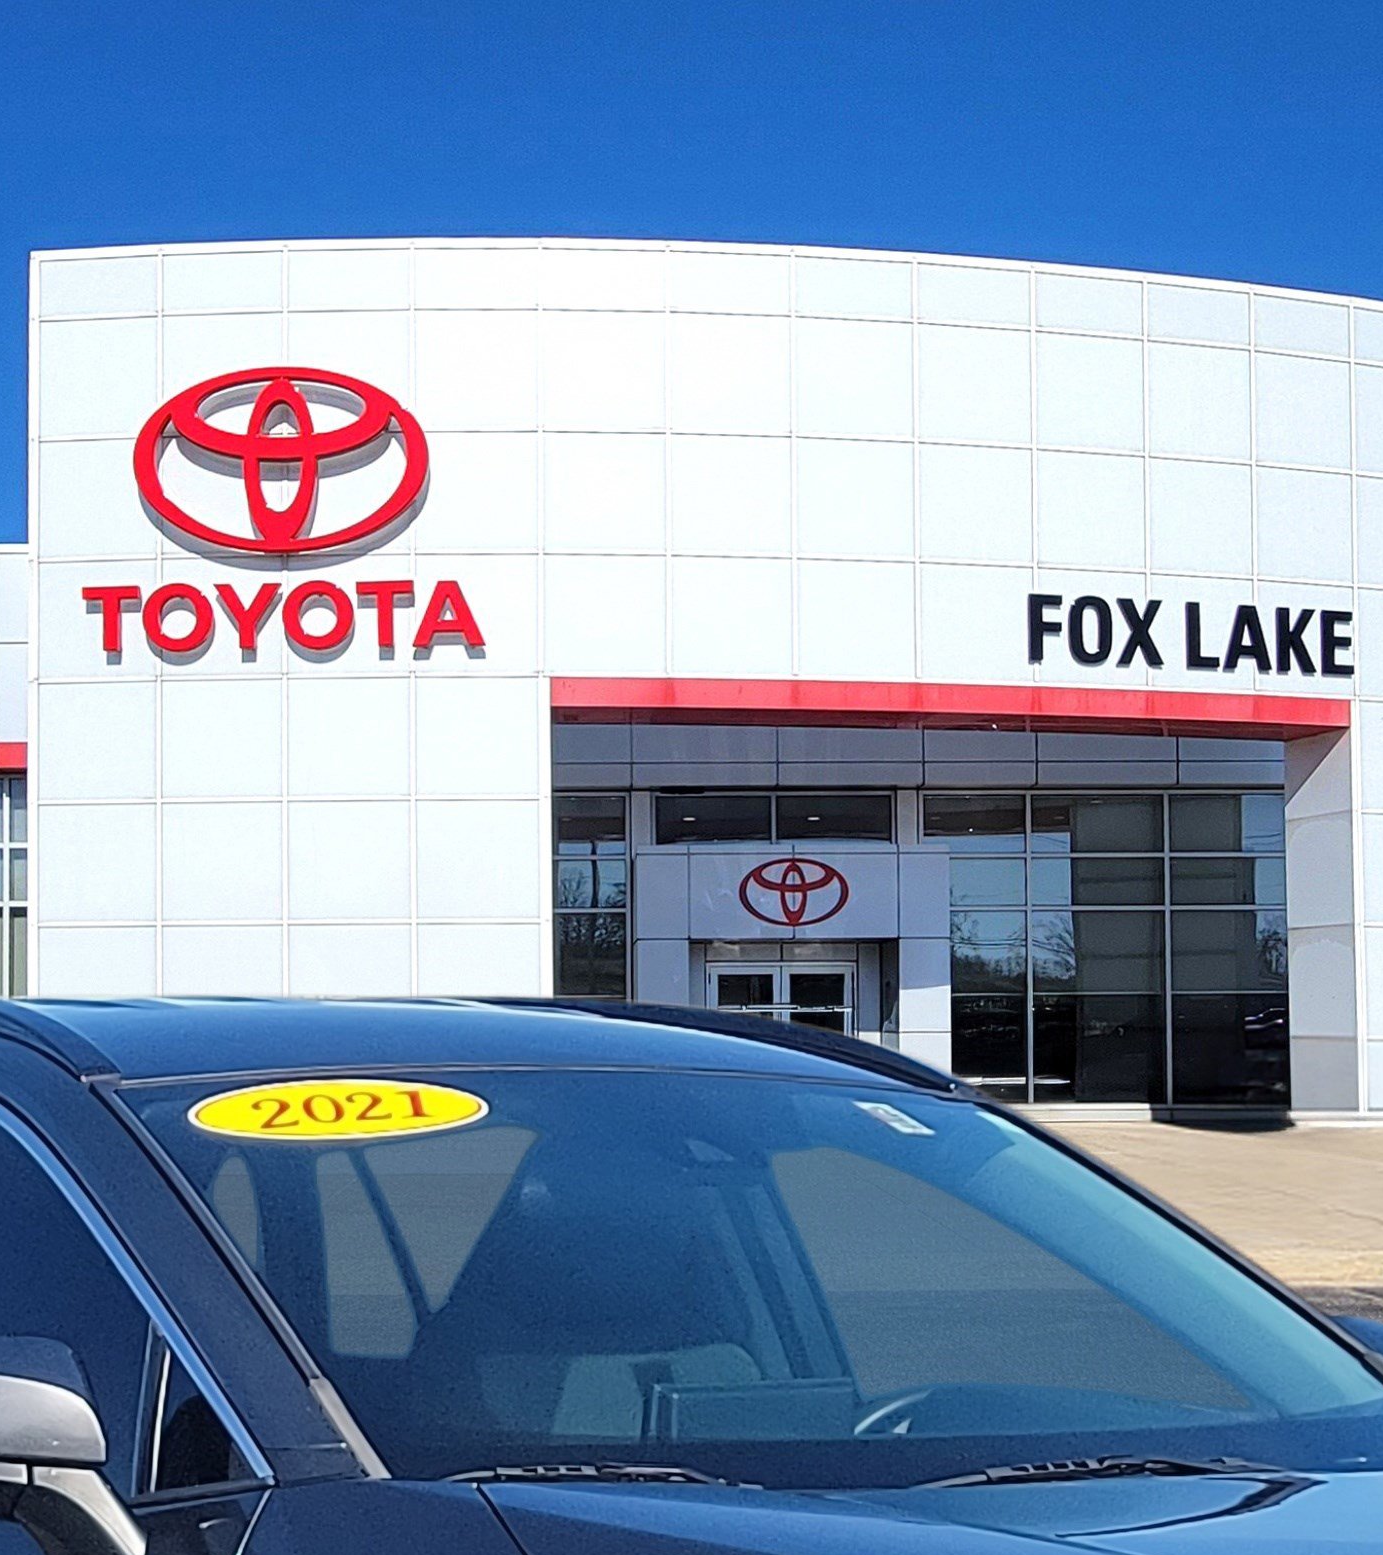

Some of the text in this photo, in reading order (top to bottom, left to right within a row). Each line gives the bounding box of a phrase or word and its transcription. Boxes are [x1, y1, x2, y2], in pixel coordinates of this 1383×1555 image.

[81, 579, 487, 660] TOYOTA
[1027, 593, 1355, 677] FOX LAKE
[251, 1089, 433, 1129] 2021
